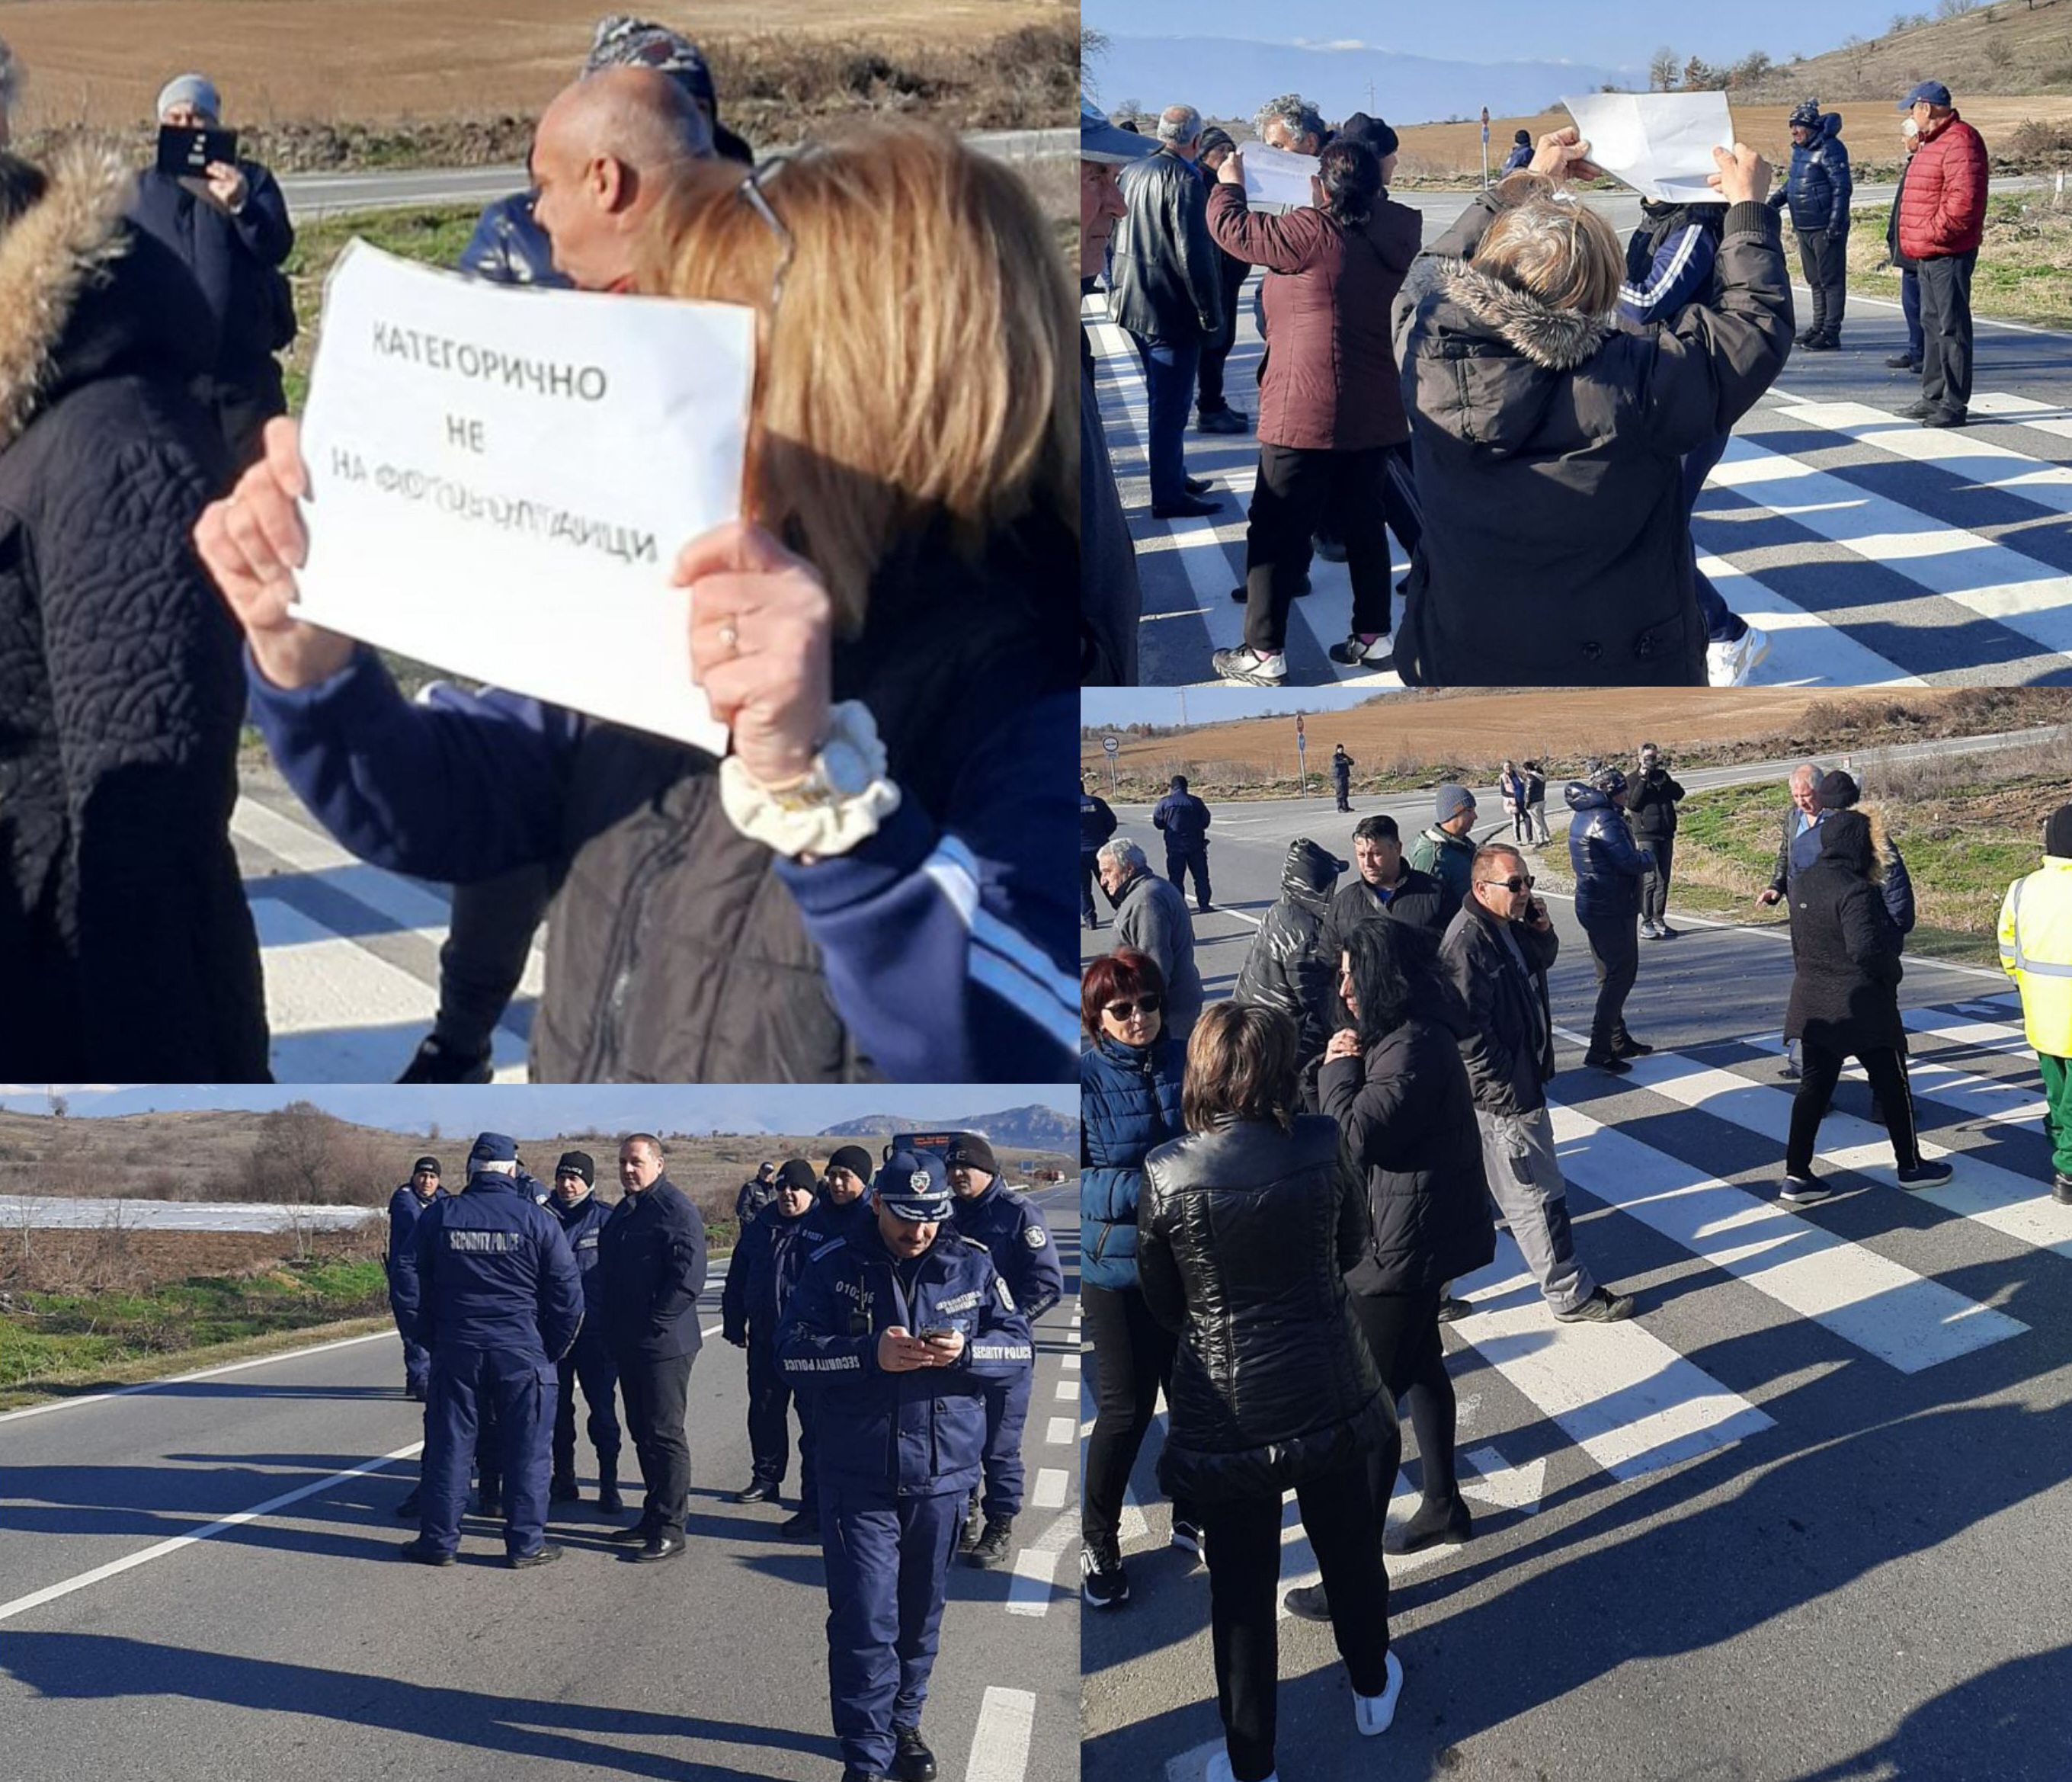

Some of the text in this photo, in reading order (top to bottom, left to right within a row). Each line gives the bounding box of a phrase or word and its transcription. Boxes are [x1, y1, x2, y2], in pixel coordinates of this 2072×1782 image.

[372, 320, 607, 401] КАТЕГОРИЧНО
[446, 414, 485, 453] НЕ
[330, 446, 367, 483] НА
[450, 1231, 520, 1252] SECURITY POLICE
[783, 1355, 860, 1371] SECURITY POLICE
[1004, 1346, 1032, 1359] POLICE
